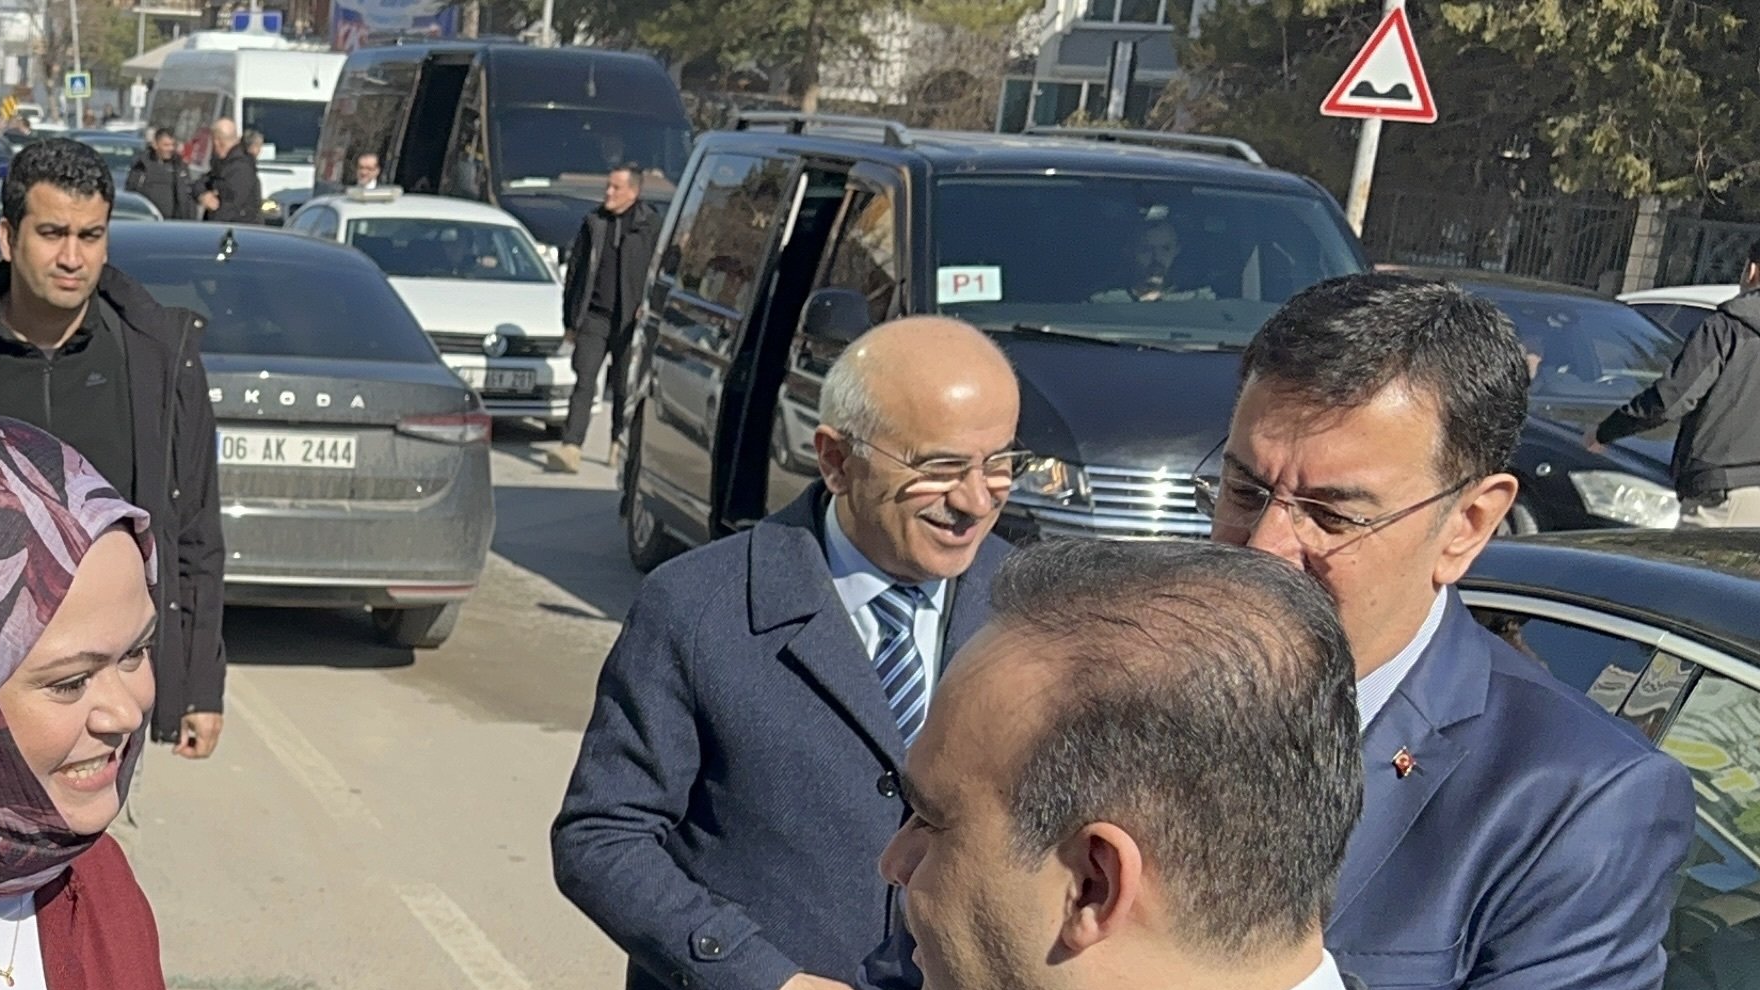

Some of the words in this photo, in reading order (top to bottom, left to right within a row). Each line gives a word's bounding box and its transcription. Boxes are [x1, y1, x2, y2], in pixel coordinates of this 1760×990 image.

[953, 273, 983, 295] P1
[208, 387, 365, 409] SKODA
[222, 436, 247, 460] 06
[262, 437, 286, 461] AK
[301, 439, 353, 464] 2444
